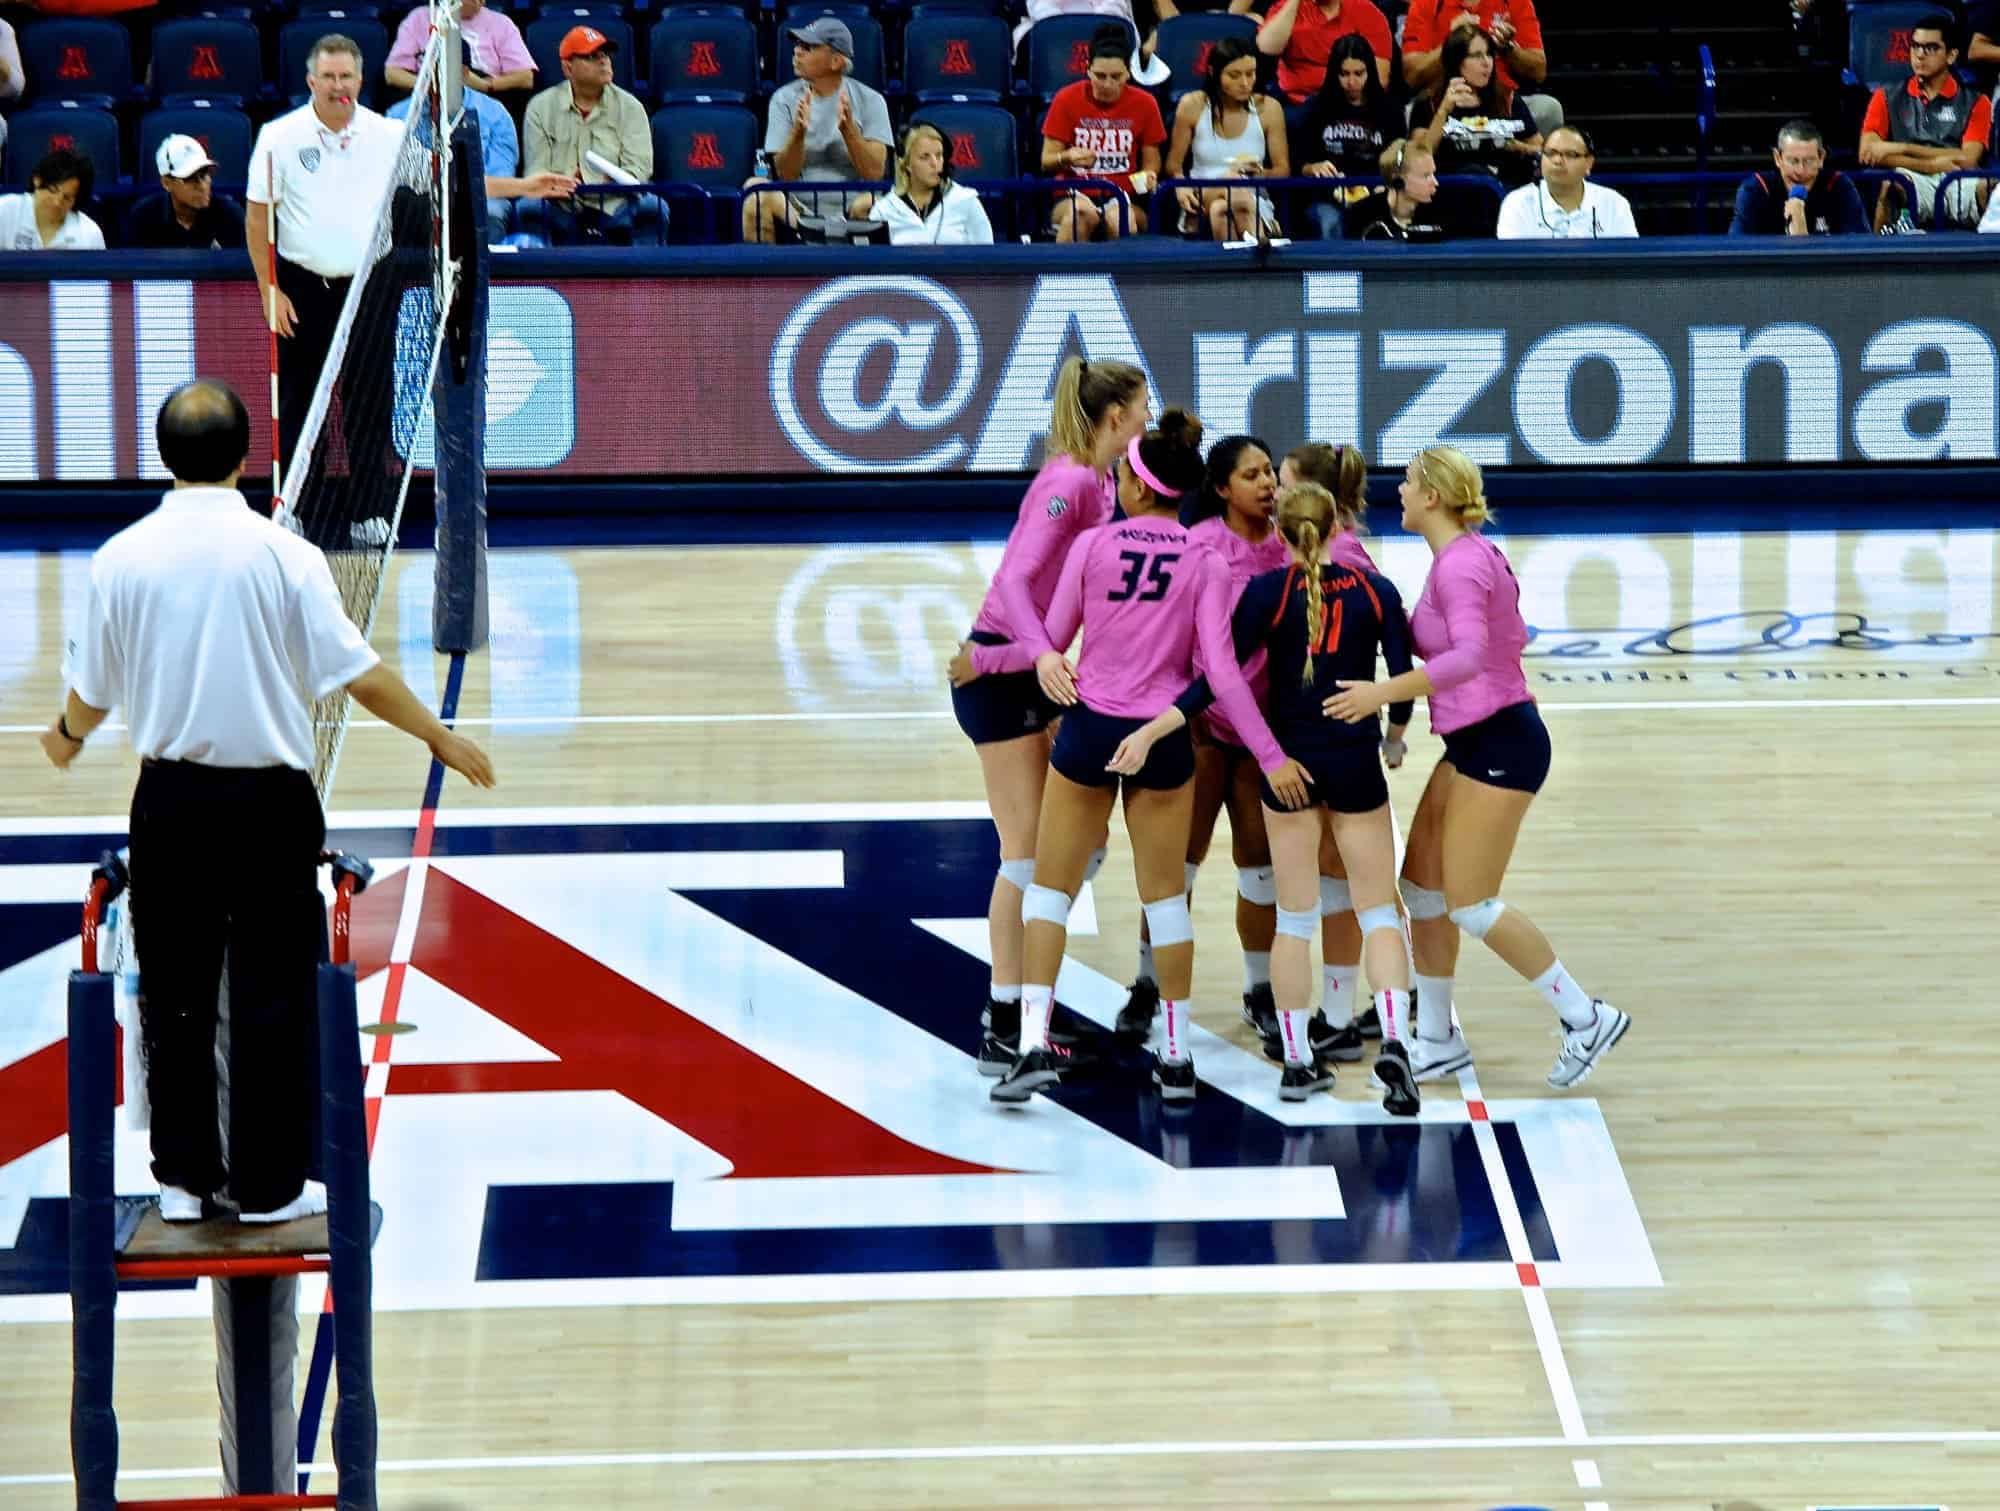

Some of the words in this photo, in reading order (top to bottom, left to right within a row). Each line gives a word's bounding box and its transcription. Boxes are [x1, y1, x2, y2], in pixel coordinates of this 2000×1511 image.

[57, 46, 94, 80] A
[188, 46, 225, 80] A
[686, 41, 721, 76] A
[939, 39, 977, 75] A
[687, 132, 726, 169] A
[950, 132, 983, 169] A
[1074, 127, 1134, 154] BEAR
[1322, 122, 1383, 145] ARIZOA
[768, 271, 2000, 474] @Arizona
[1107, 549, 1182, 602] 35
